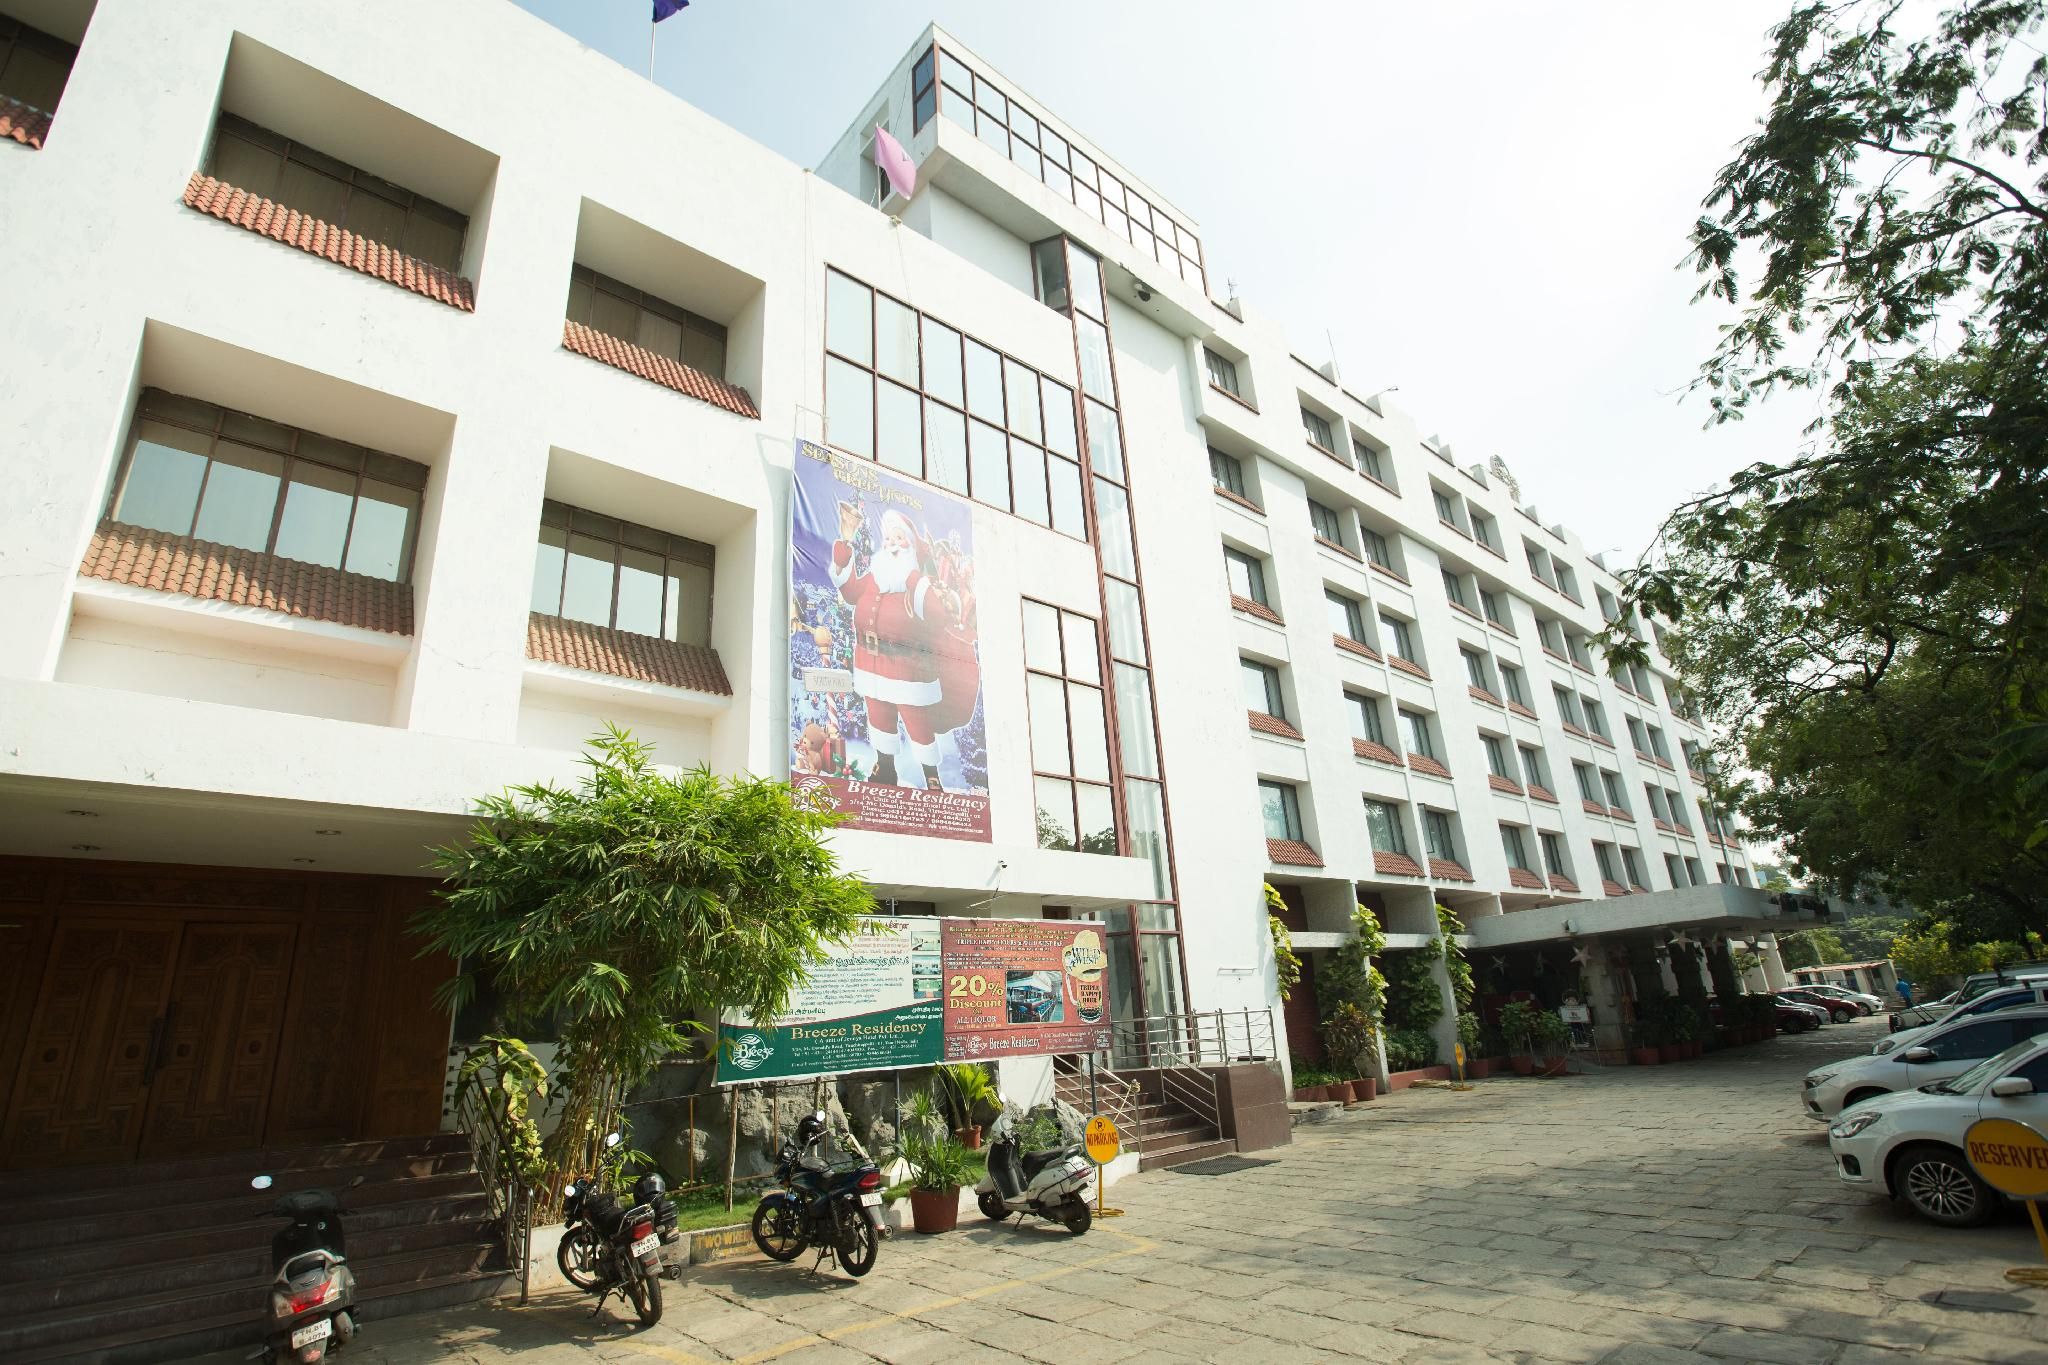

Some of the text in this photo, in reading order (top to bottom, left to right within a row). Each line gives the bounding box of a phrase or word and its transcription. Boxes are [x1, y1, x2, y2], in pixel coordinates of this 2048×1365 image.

[847, 780, 987, 811] Breeze Residency
[1071, 947, 1101, 958] WILD
[1075, 957, 1099, 965] WEST
[950, 975, 1004, 997] 20%
[949, 998, 1003, 1009] Discount
[791, 1021, 927, 1040] Breeze Residency
